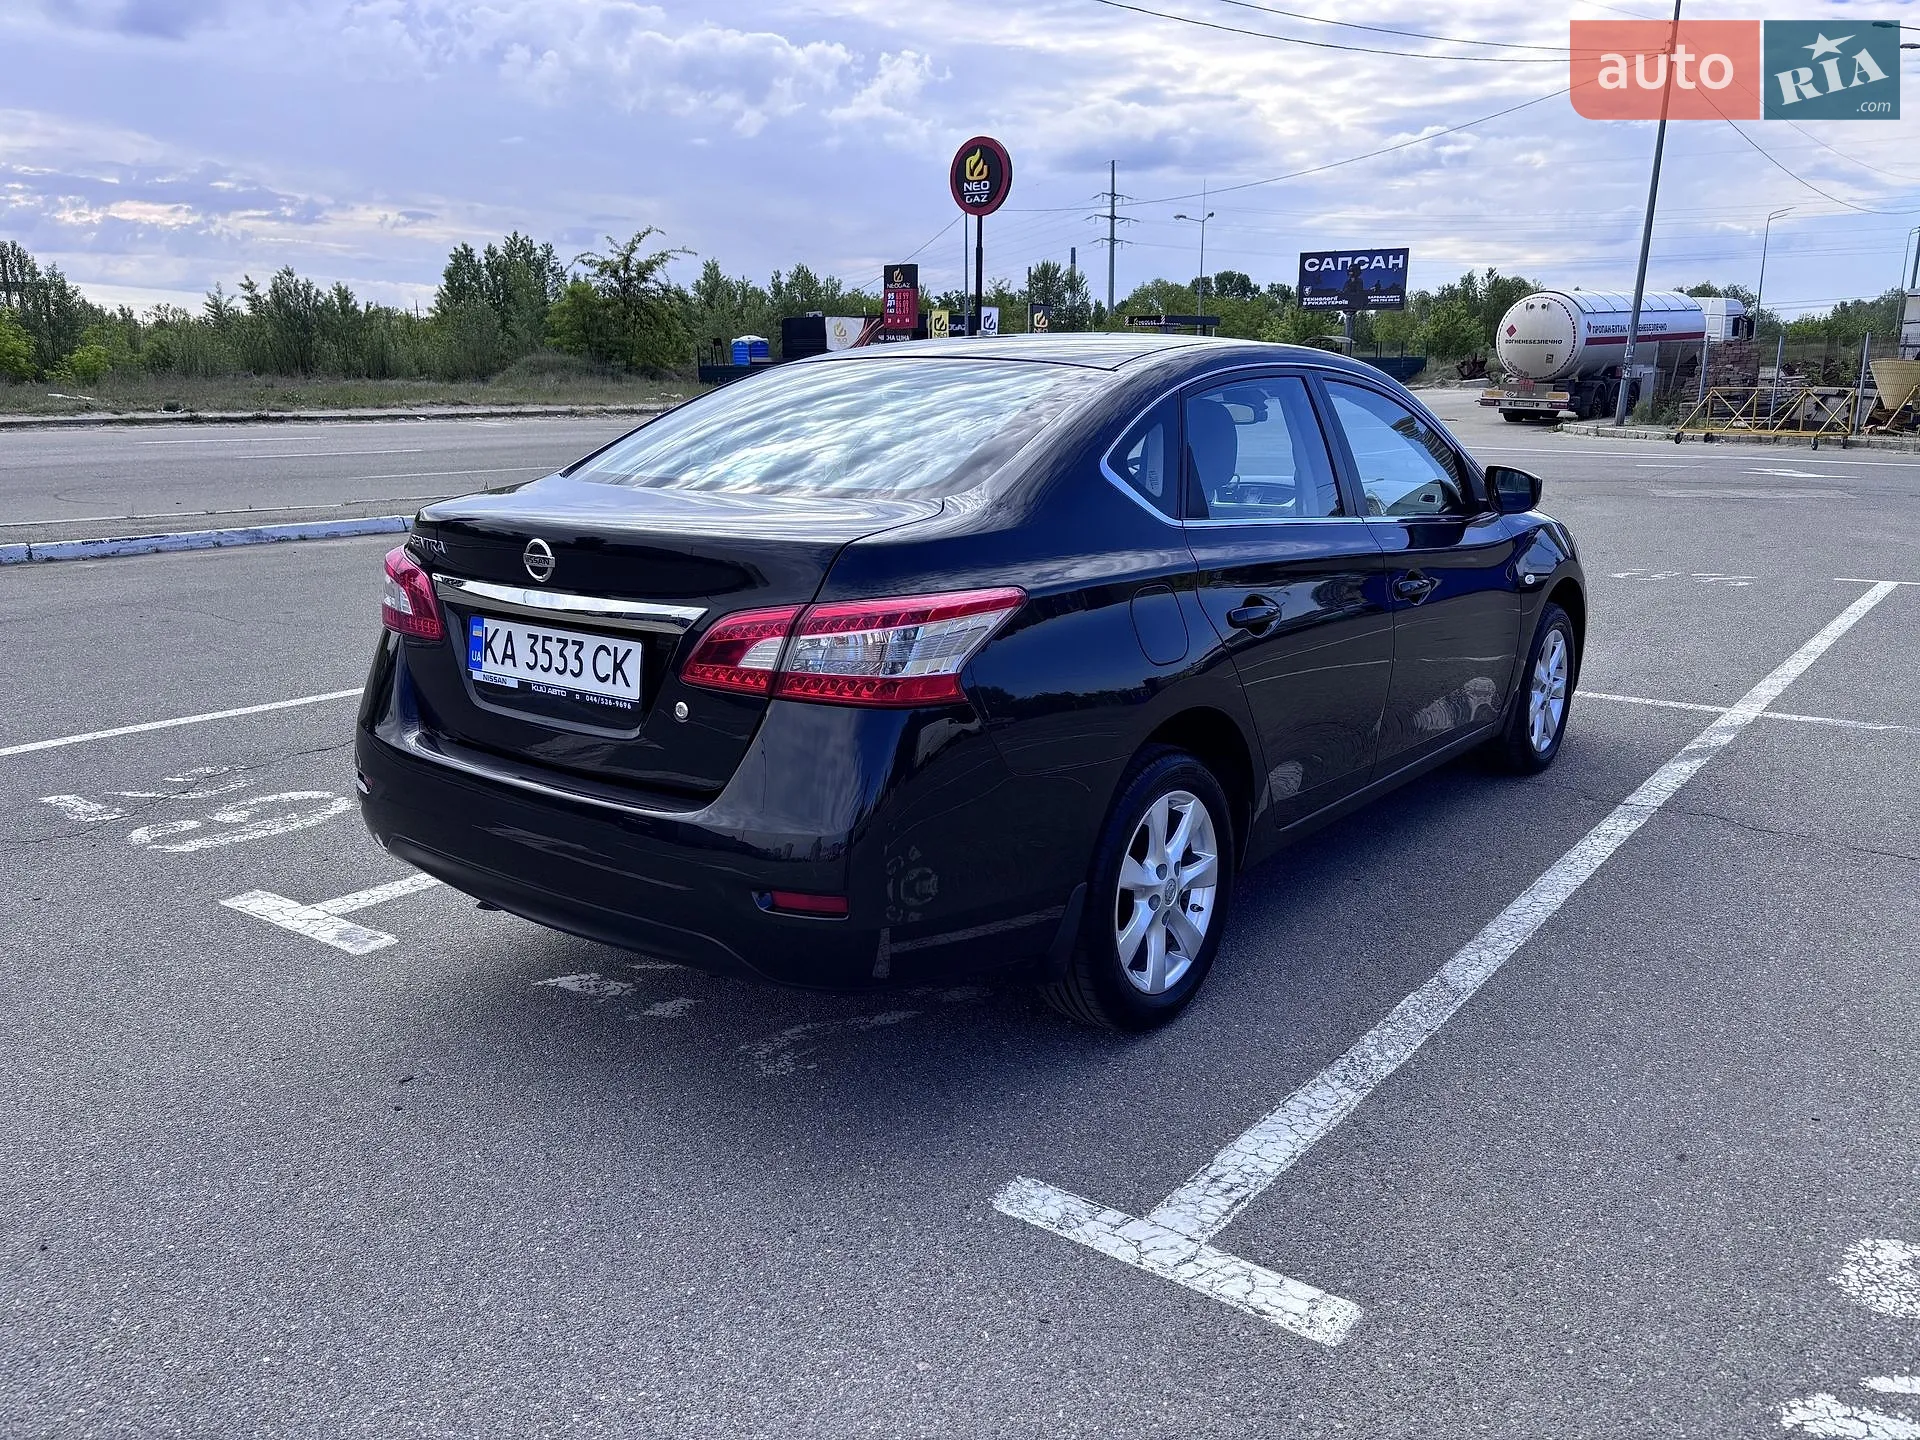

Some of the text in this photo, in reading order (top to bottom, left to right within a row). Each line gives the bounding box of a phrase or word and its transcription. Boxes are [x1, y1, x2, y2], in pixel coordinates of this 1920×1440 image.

[963, 180, 990, 191] NEO
[965, 194, 988, 204] GAZ
[1304, 254, 1404, 272] САПСАН
[471, 650, 482, 663] UA
[483, 626, 633, 688] KA 3533 CK
[482, 674, 508, 685] NISSAN
[585, 695, 632, 710] 044/536-9696
